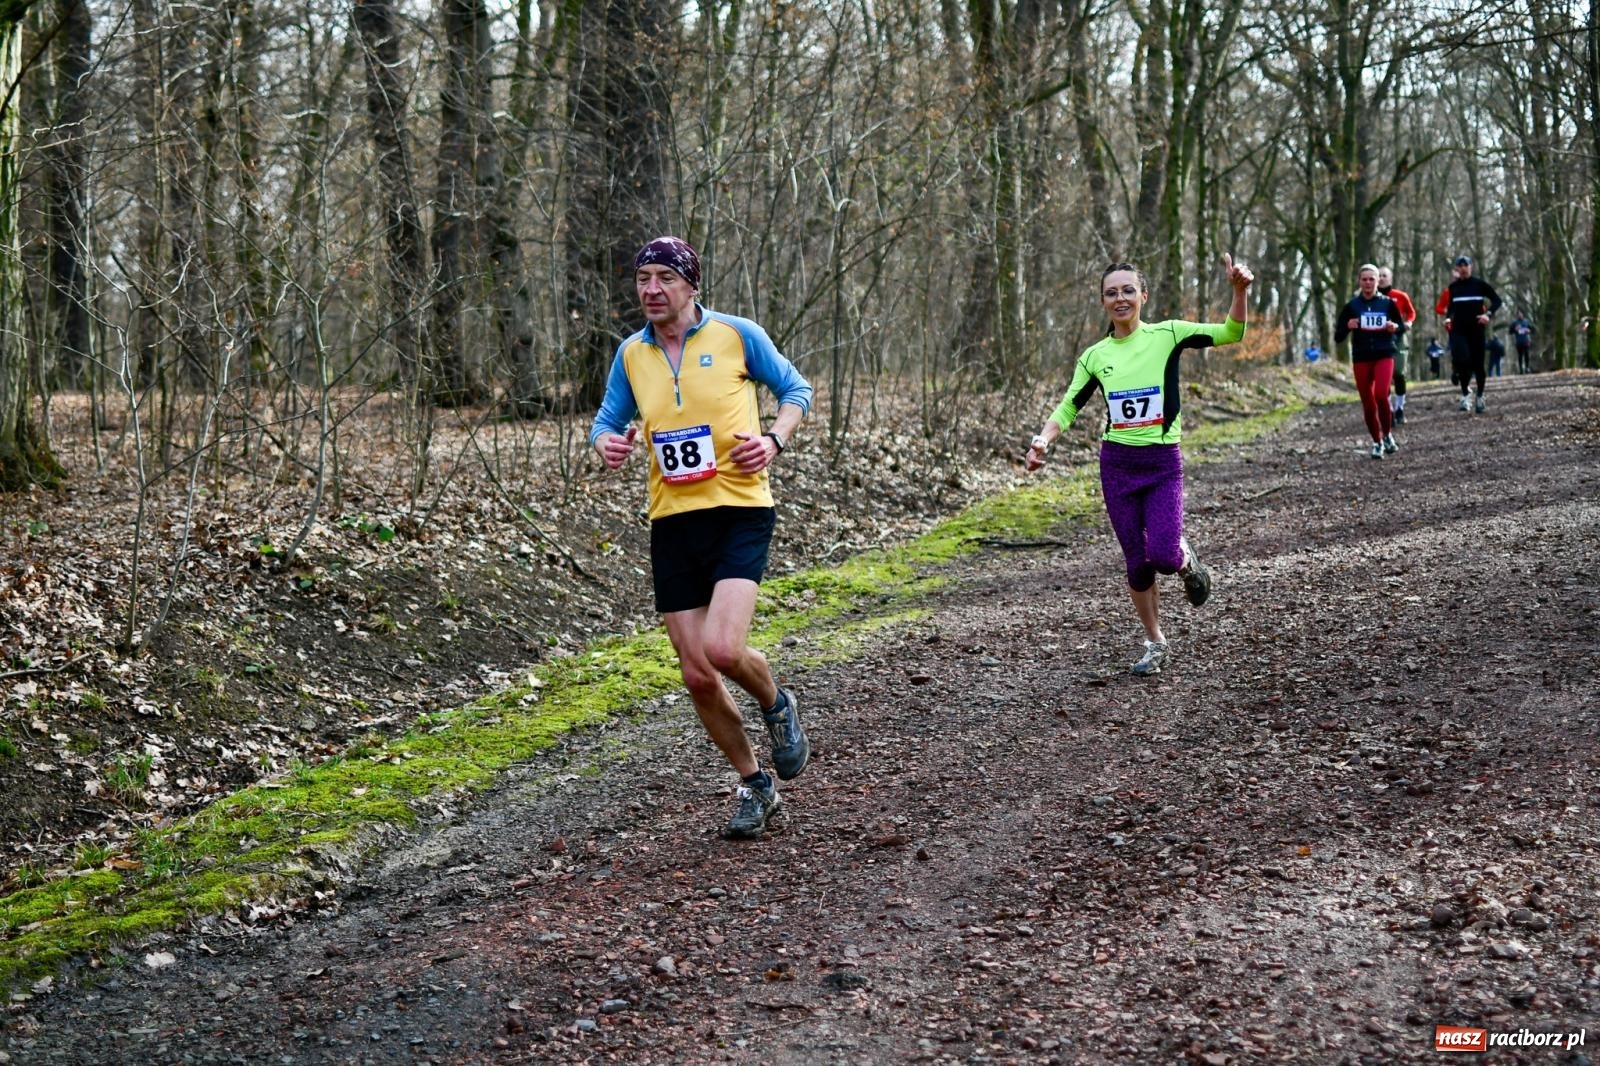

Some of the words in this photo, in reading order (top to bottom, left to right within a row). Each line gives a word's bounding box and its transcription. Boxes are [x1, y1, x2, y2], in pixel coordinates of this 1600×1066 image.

[1366, 316, 1383, 326] 118
[1121, 397, 1150, 420] 67
[662, 440, 701, 471] 88
